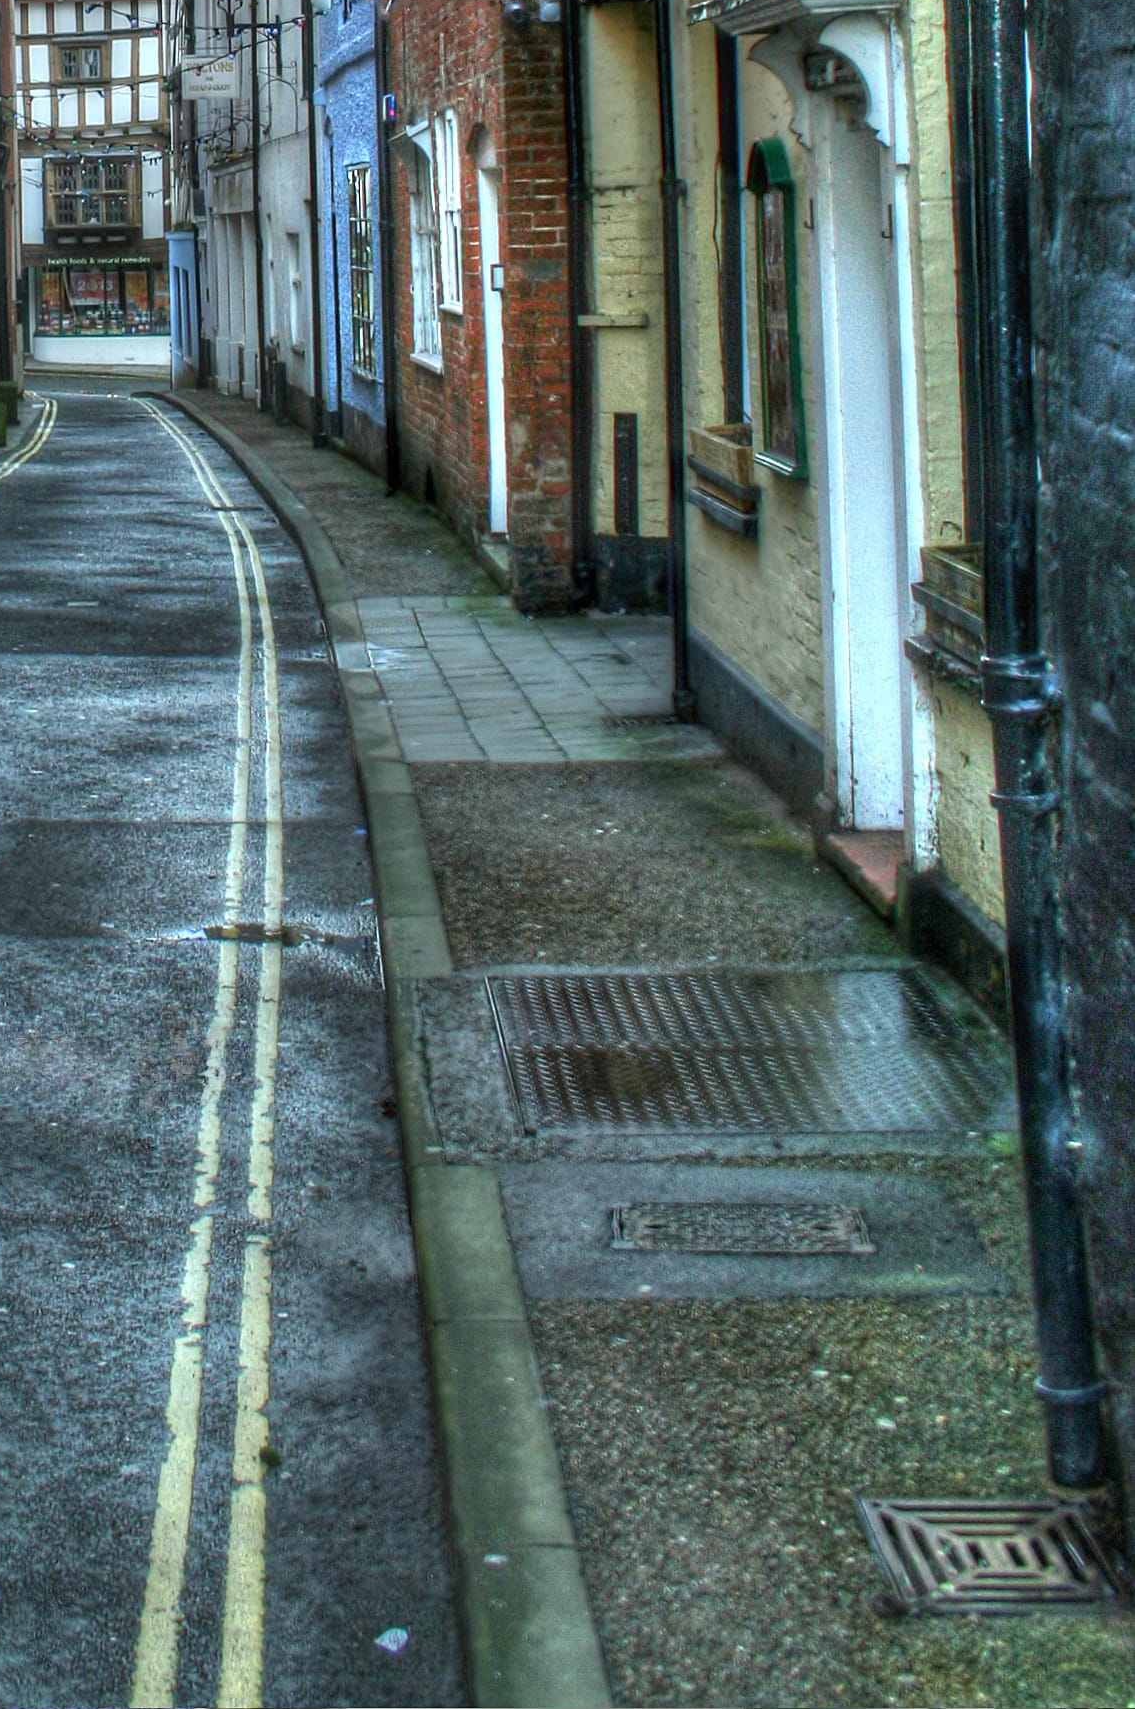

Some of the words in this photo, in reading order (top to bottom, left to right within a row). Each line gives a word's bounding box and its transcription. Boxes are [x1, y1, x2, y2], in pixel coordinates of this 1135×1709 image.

[47, 257, 68, 265] health
[69, 257, 87, 265] foods
[121, 256, 151, 264] remedies
